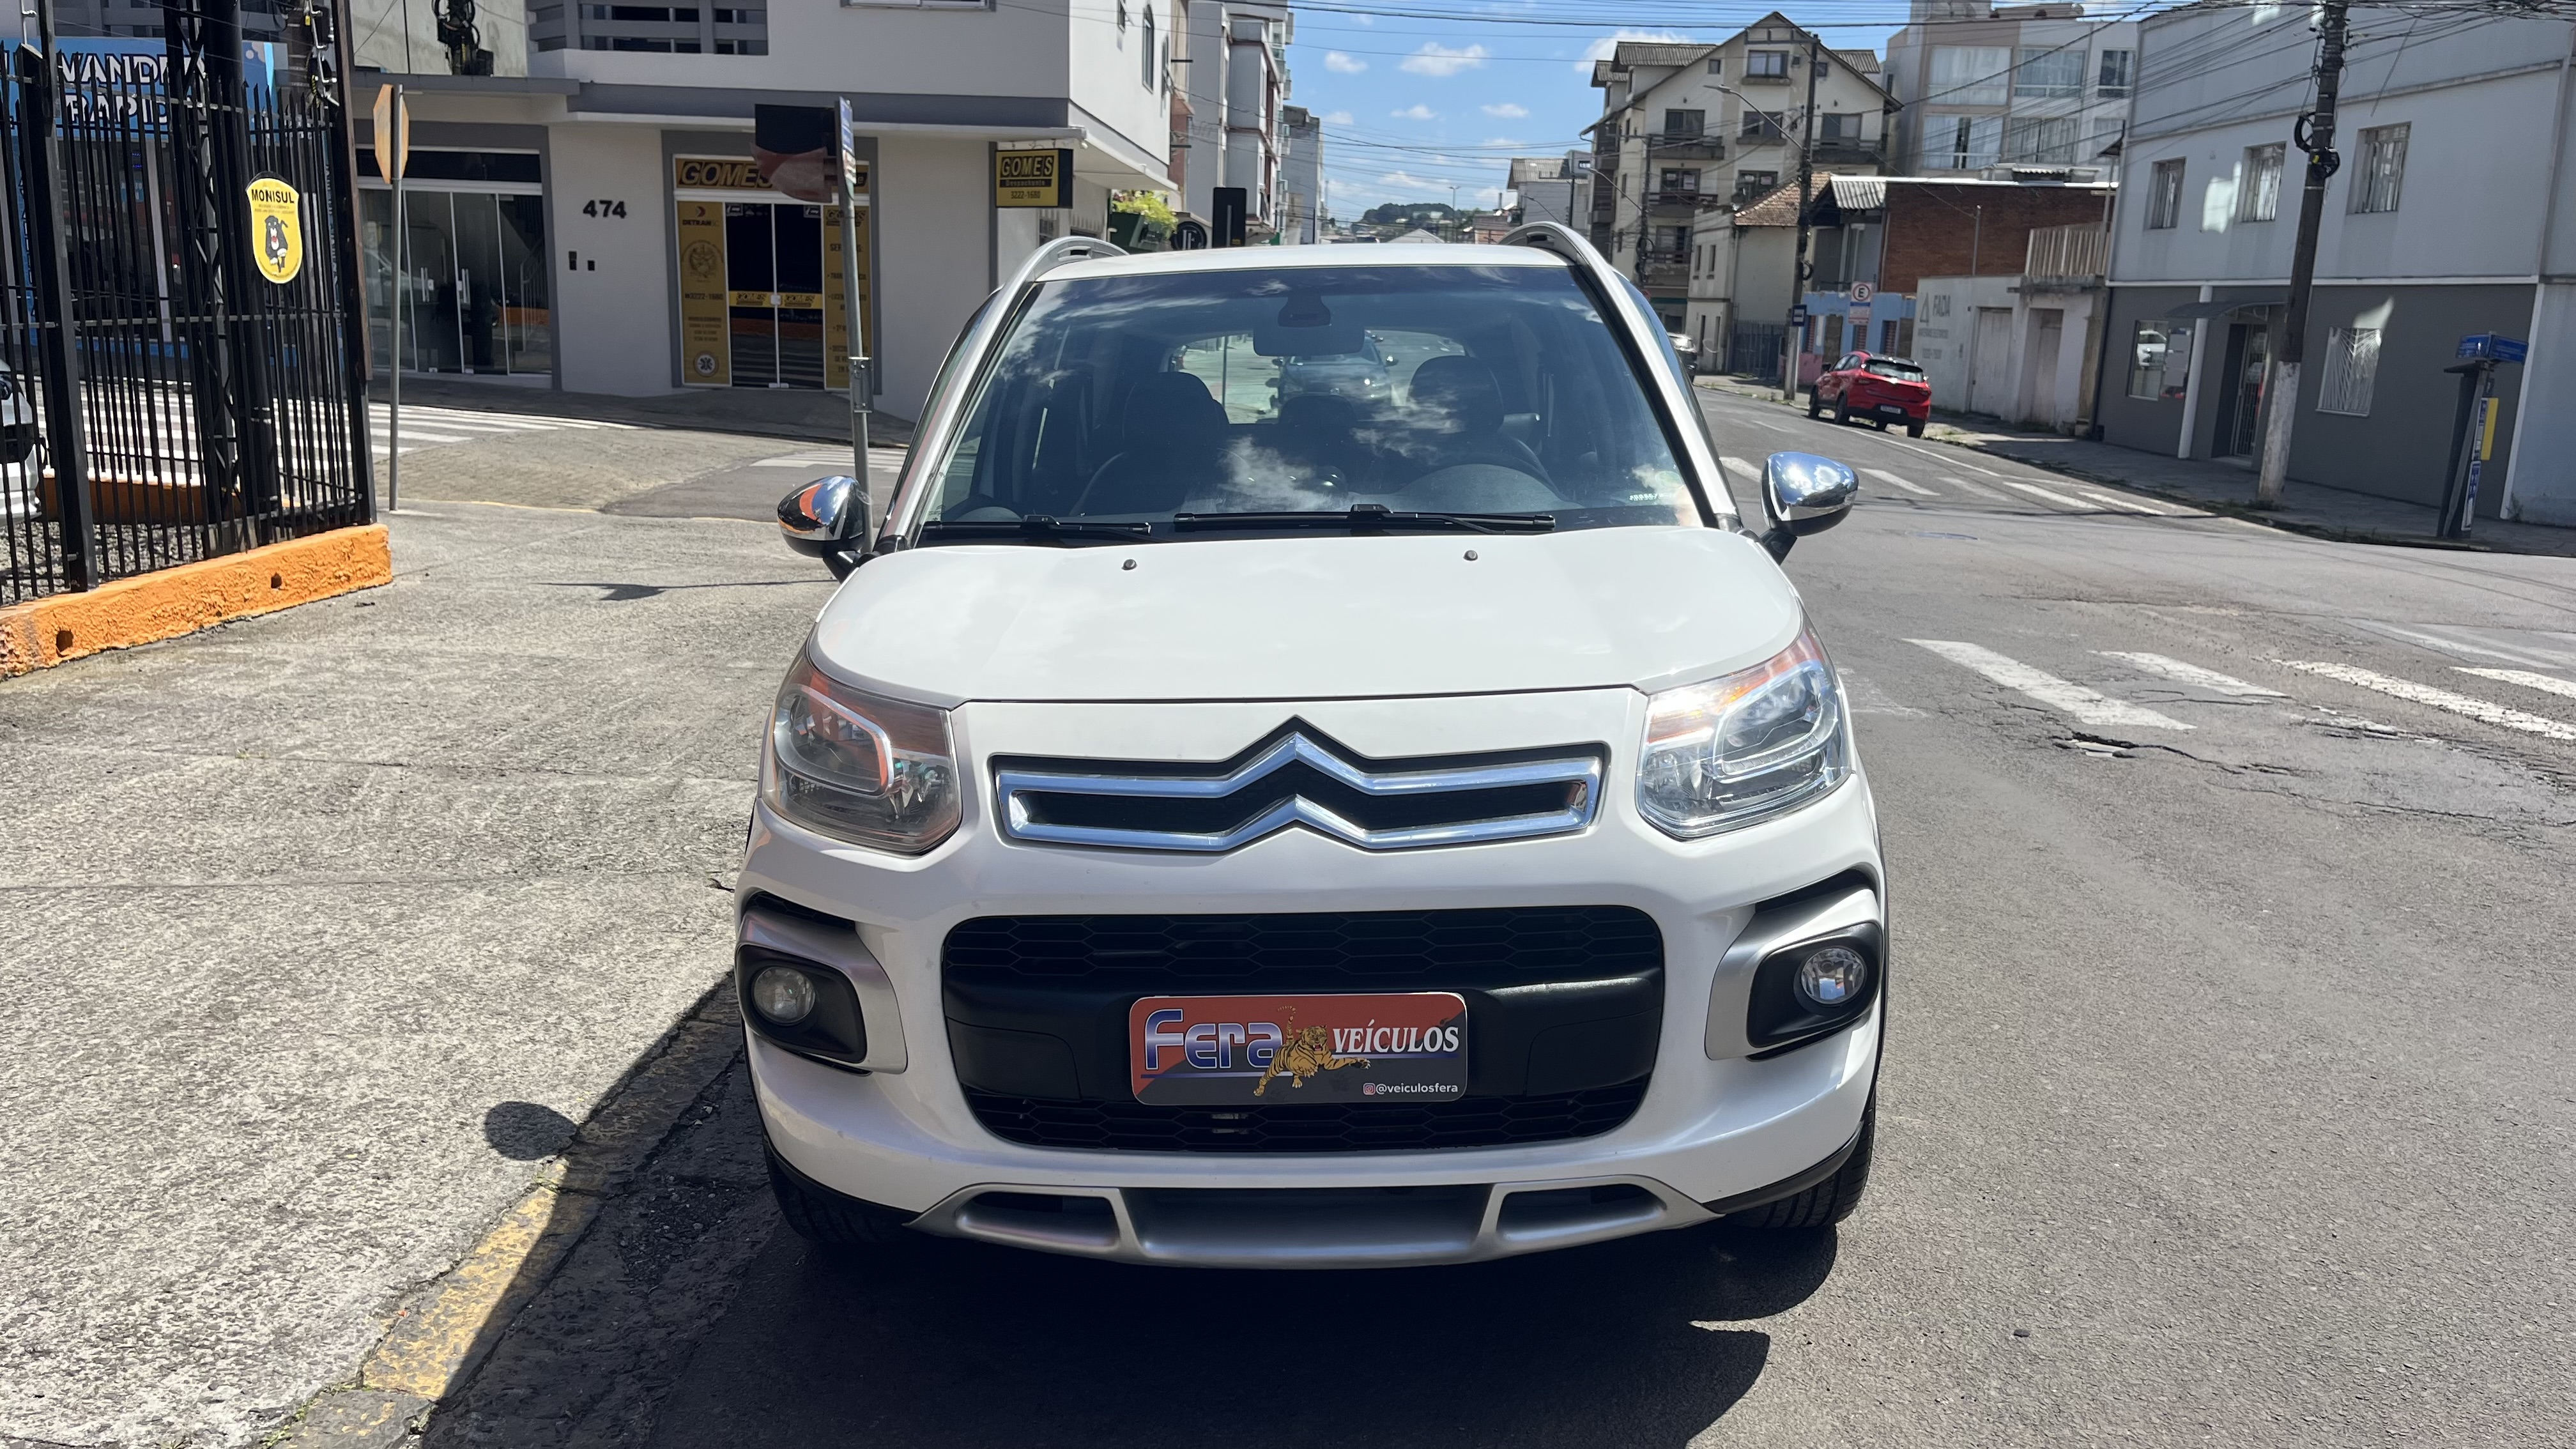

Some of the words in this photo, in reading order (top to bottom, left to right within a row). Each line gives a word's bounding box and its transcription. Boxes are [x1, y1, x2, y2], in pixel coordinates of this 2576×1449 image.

[1002, 157, 1054, 176] GOMES
[251, 188, 295, 204] MONISUL
[582, 199, 627, 219] 474
[1858, 288, 1866, 298] E
[1145, 1008, 1283, 1070] Fera
[1333, 1019, 1459, 1053] VEÍCULOS
[1376, 1082, 1459, 1095] @veiculosfera
